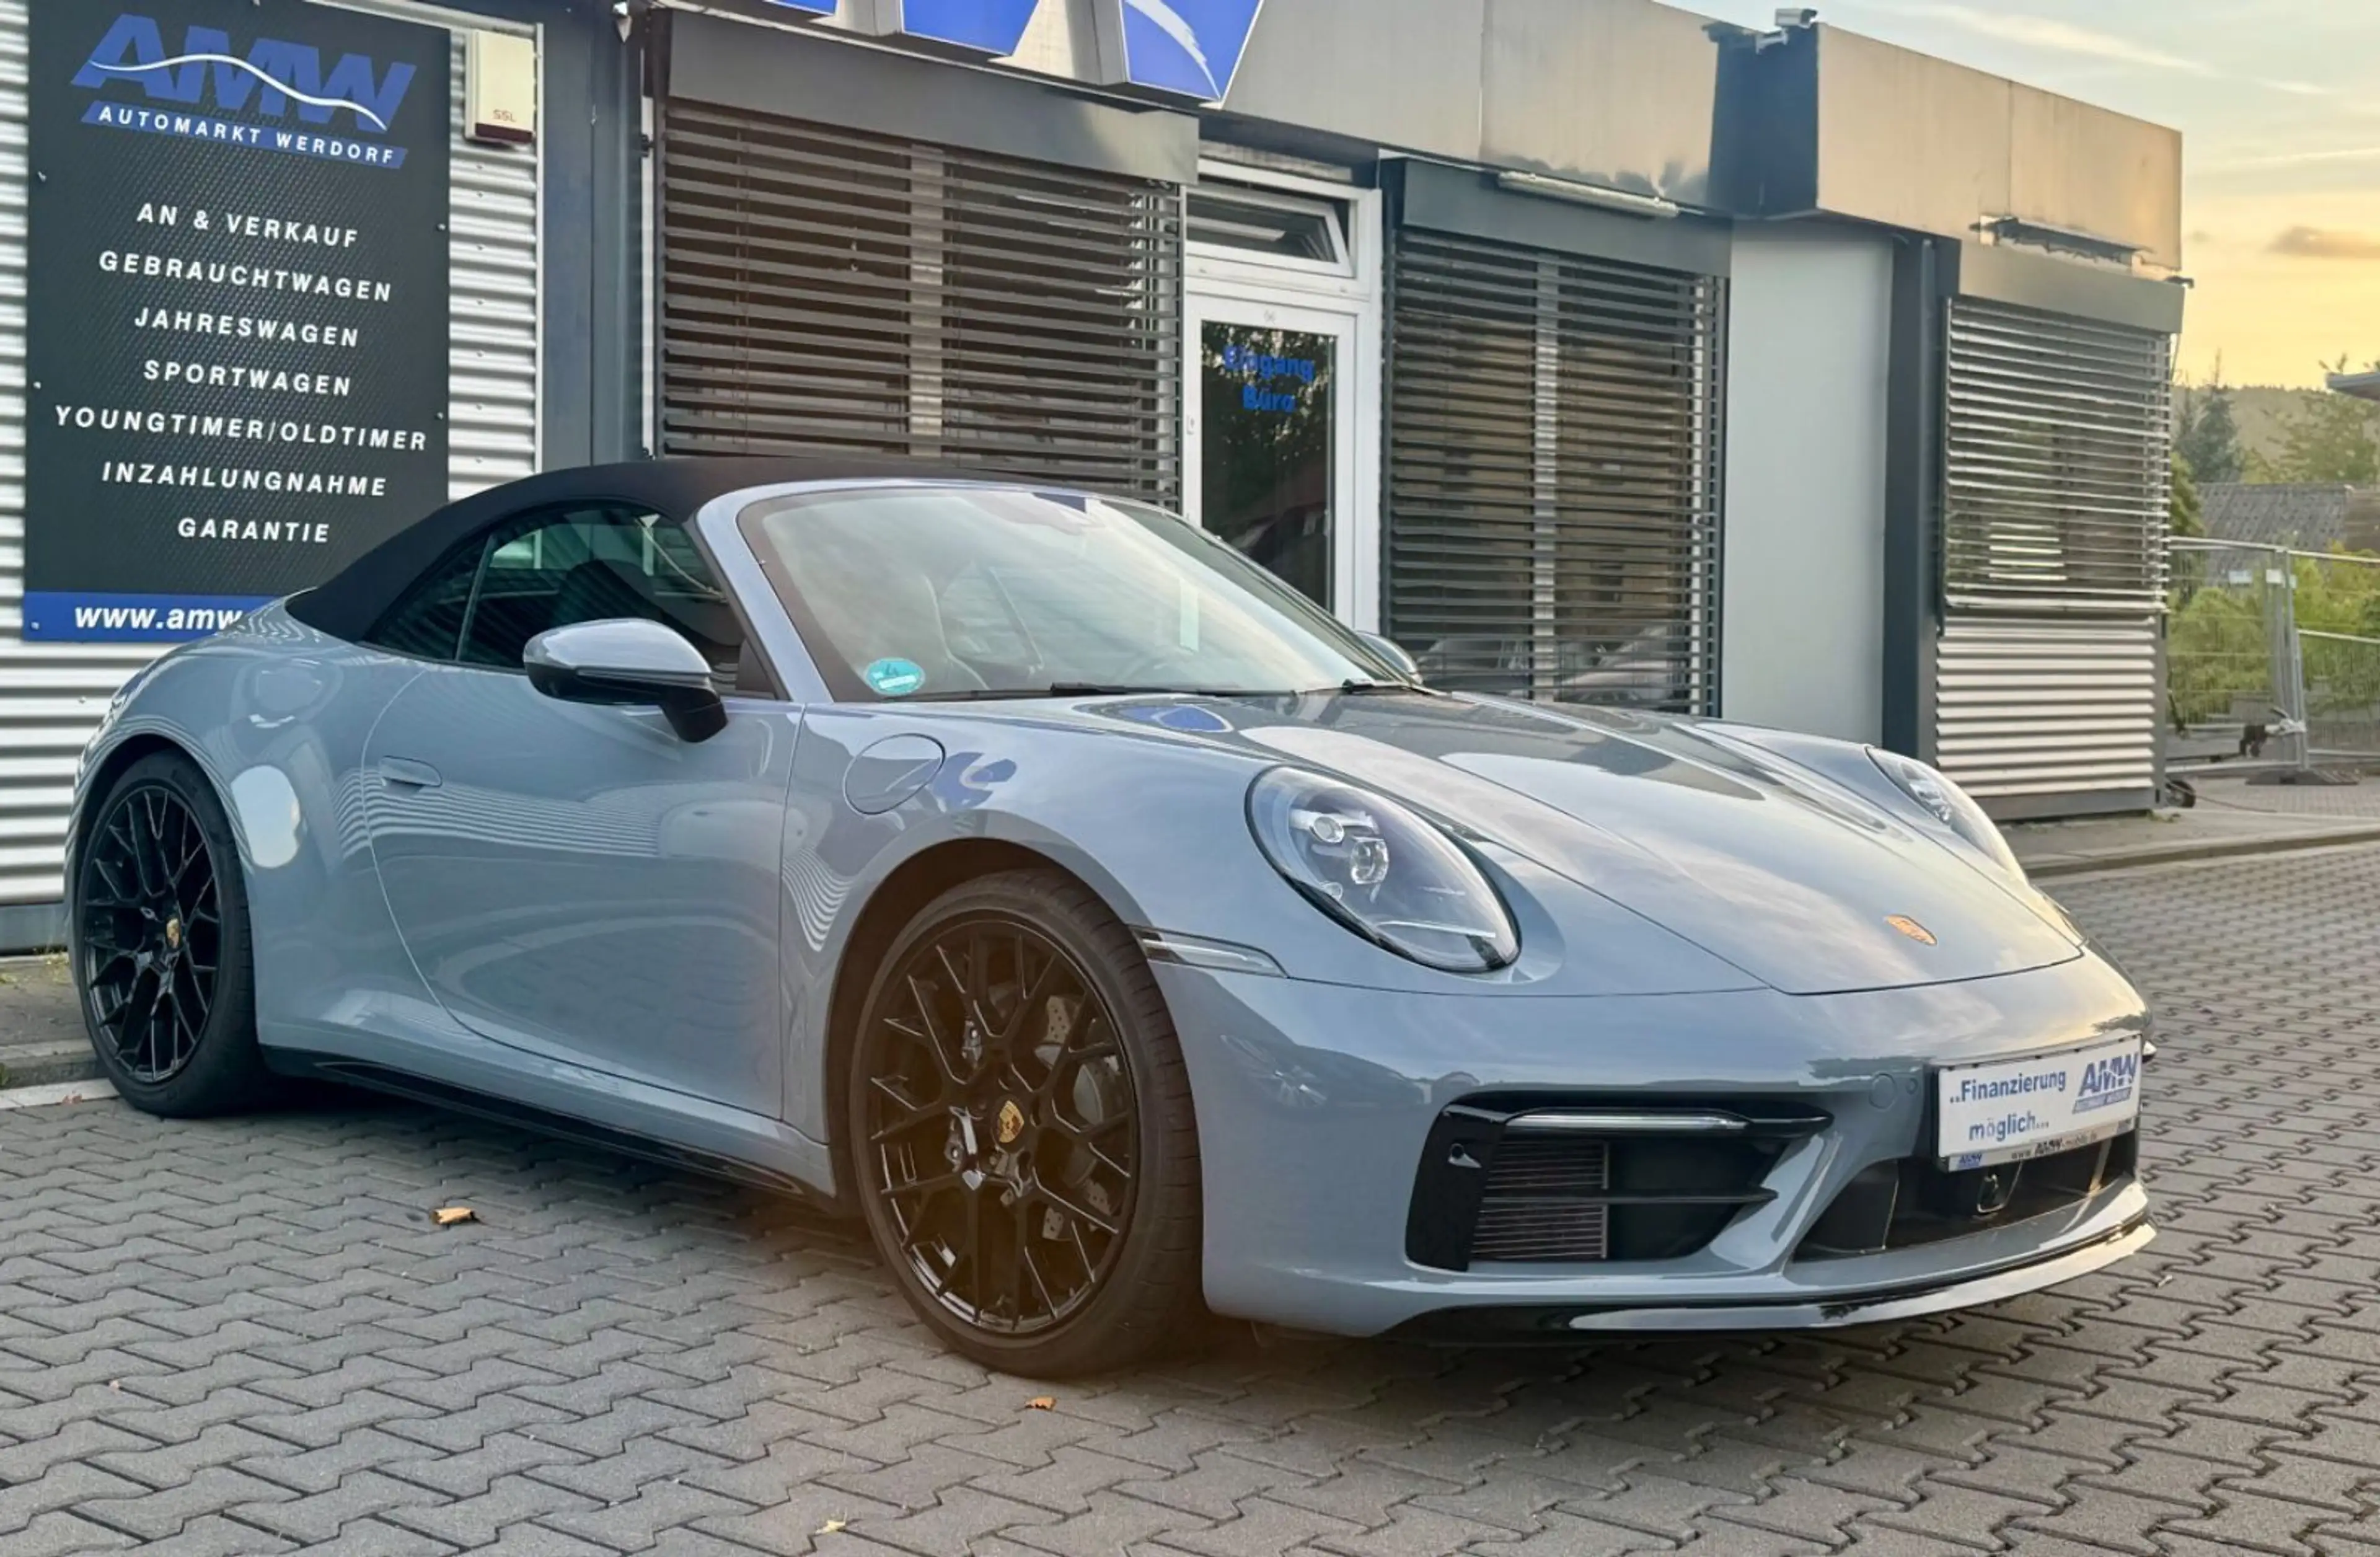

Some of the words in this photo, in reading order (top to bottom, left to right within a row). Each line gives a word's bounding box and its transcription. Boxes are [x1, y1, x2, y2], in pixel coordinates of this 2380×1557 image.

[71, 13, 416, 133] AMW
[98, 106, 262, 143] AUTOMARKT
[276, 132, 394, 164] WERDORF
[136, 203, 178, 226] AN
[193, 210, 209, 230] &
[227, 214, 358, 247] VERKAUF
[99, 250, 391, 302] GEBRAUCHTWAGEN
[134, 307, 358, 347] JAHRESWAGEN
[144, 359, 351, 396] SPORTWAGEN
[1223, 344, 1315, 383] Eingang
[1243, 383, 1296, 412] Büro
[56, 406, 426, 451] YOUNGTIMER/OLDTIMER
[102, 462, 387, 496] INZAHLUNGNAHME
[178, 518, 330, 542] GARANTIE
[2078, 1052, 2138, 1096] AMW
